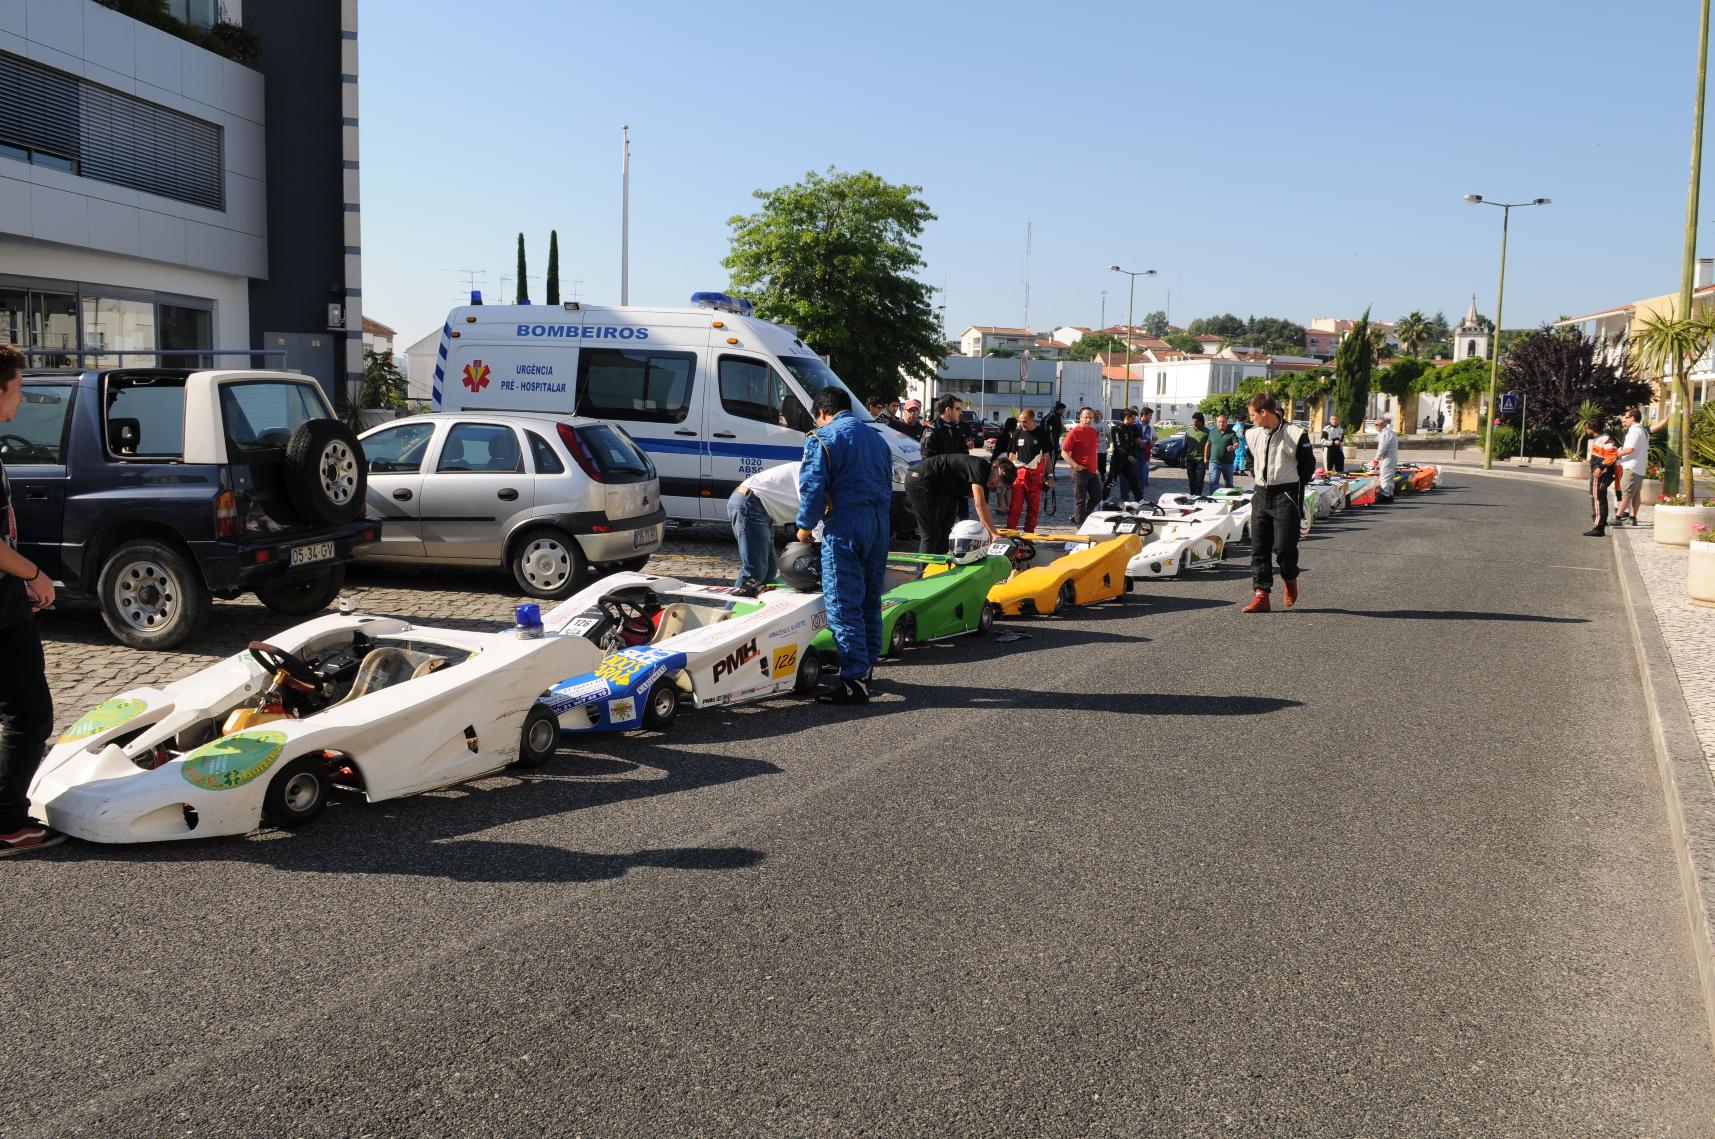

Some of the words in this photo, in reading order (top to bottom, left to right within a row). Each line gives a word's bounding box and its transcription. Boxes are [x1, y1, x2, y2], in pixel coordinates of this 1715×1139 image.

[516, 324, 649, 340] BOMBEIROS
[516, 363, 553, 375] URGÊNCIA
[520, 381, 566, 393] HOSPITALAR
[740, 458, 762, 466] 1020
[573, 619, 593, 627] 126
[712, 637, 758, 684] PMH
[774, 650, 797, 671] 126
